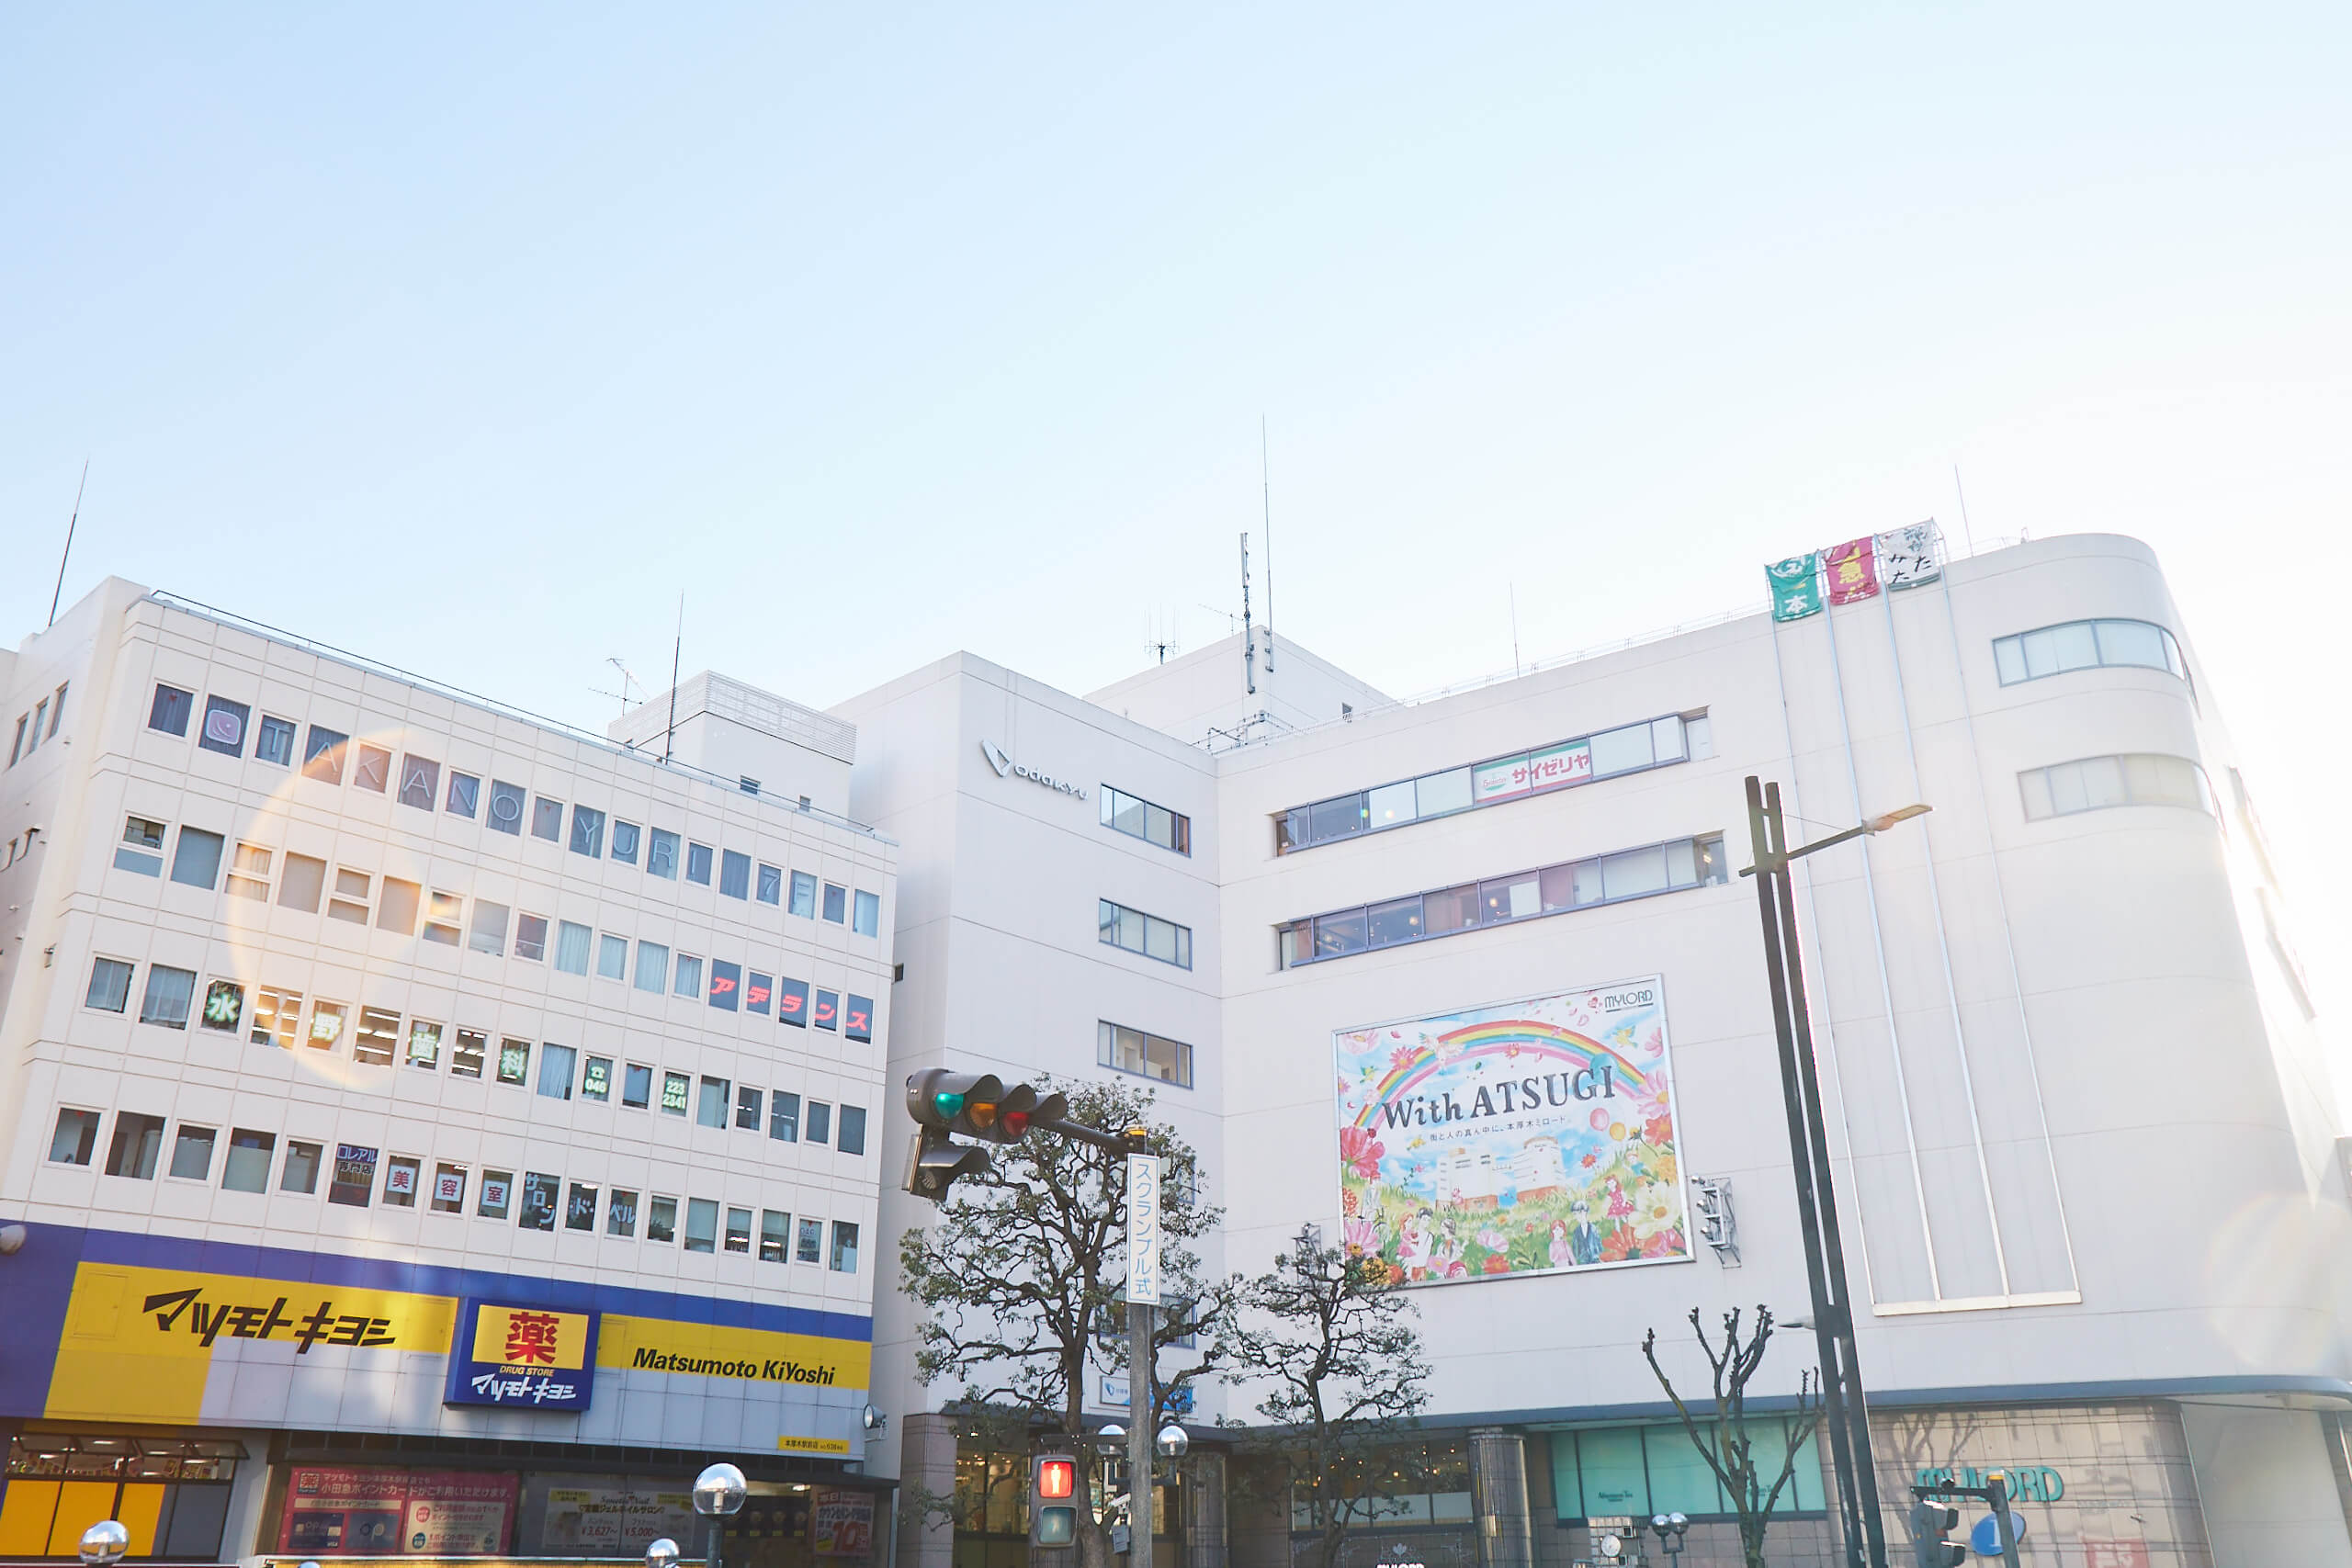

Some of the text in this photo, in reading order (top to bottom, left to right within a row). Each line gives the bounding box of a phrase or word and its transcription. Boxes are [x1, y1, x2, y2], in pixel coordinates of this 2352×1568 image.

[1014, 764, 1089, 800] odakyu
[1512, 754, 1589, 784] サイゼリヤ
[268, 716, 521, 821] TAKANO
[579, 816, 697, 873] YURI
[710, 976, 867, 1032] アデランス
[1604, 989, 1654, 1009] MYLORD
[1384, 1065, 1617, 1130] With ATSUGI
[337, 1145, 377, 1163] ロレアル
[504, 1312, 560, 1365] 薬
[499, 1366, 555, 1377] DRUG STORE
[633, 1348, 836, 1385] Matsumoto KiYoshi
